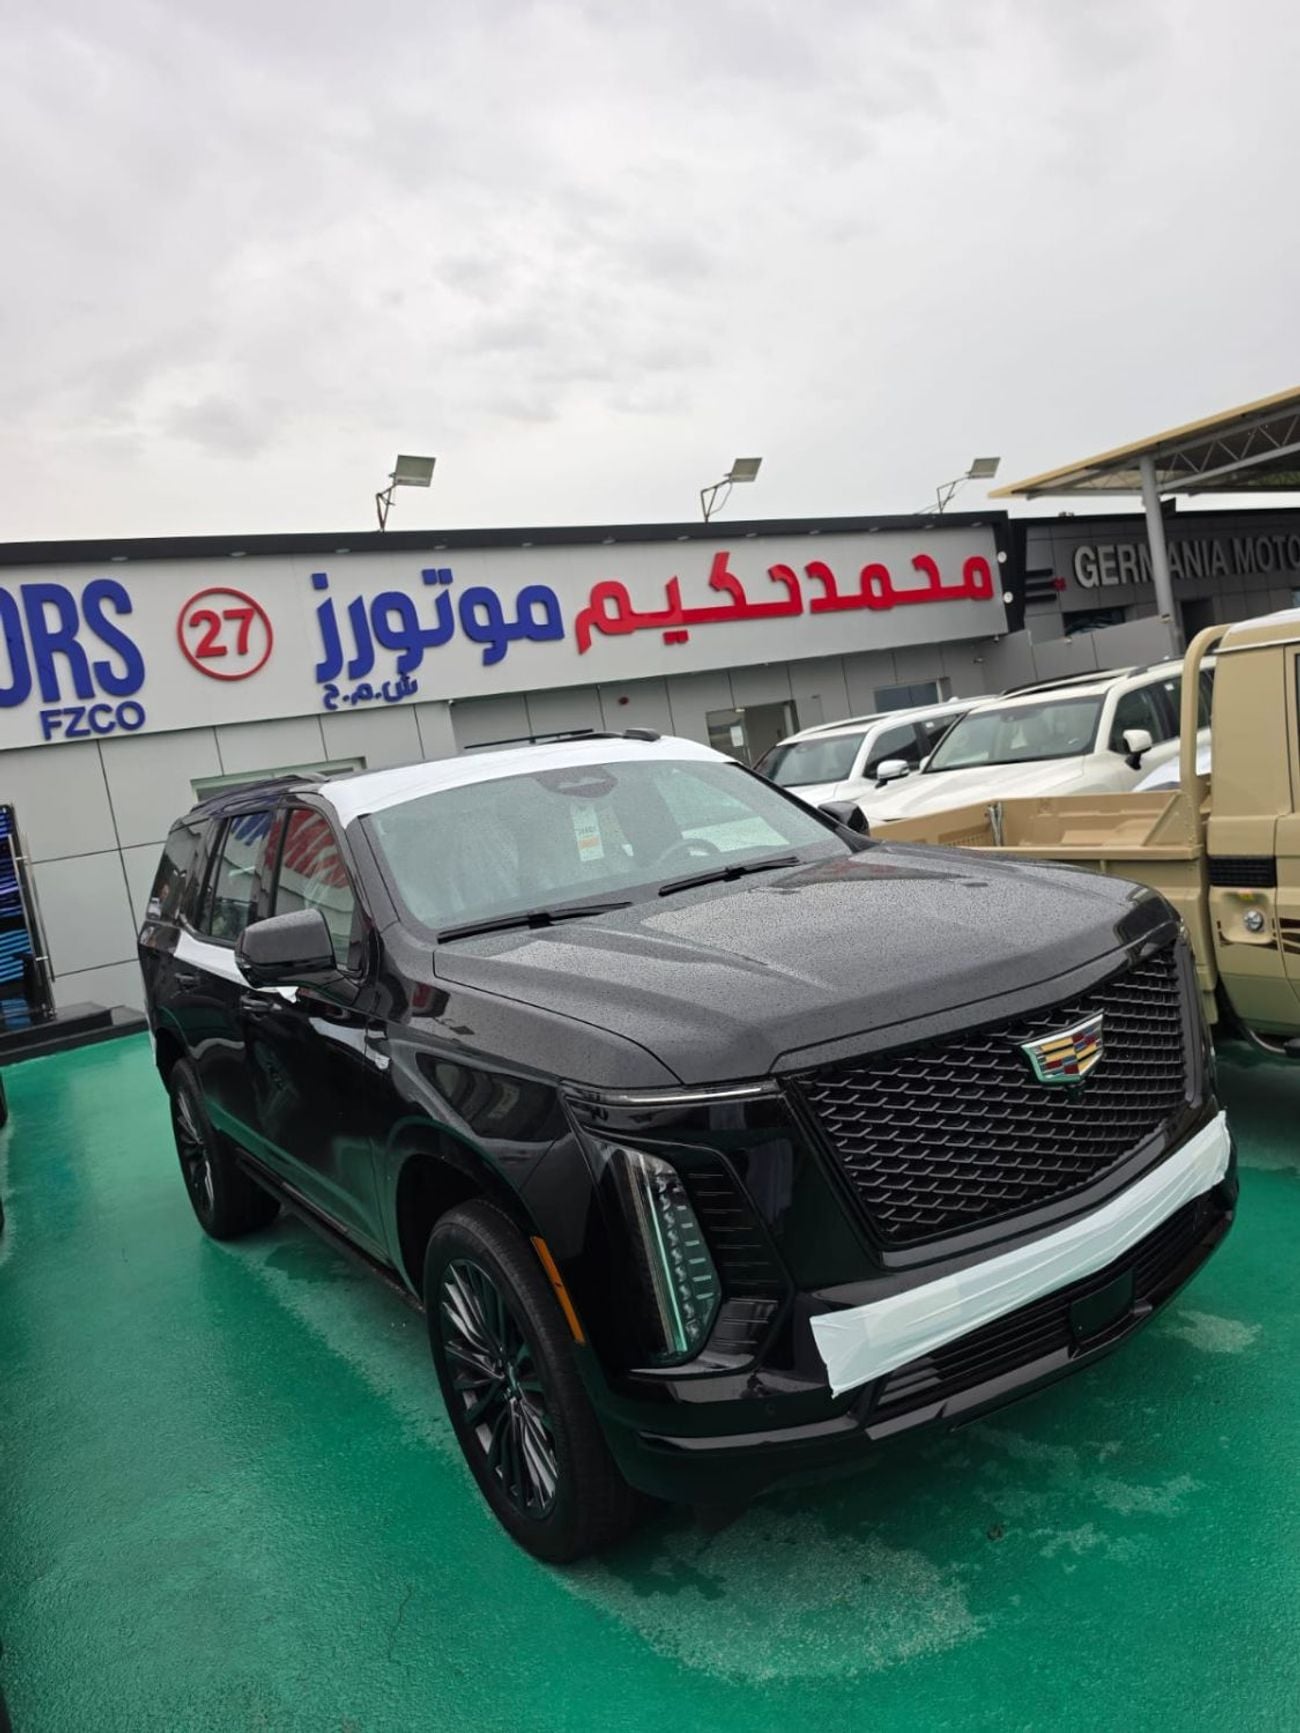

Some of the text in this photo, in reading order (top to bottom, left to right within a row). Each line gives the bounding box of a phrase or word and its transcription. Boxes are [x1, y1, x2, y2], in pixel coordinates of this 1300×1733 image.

[189, 608, 257, 659] 27
[312, 568, 565, 684] موتورز
[40, 701, 146, 741] FZCO
